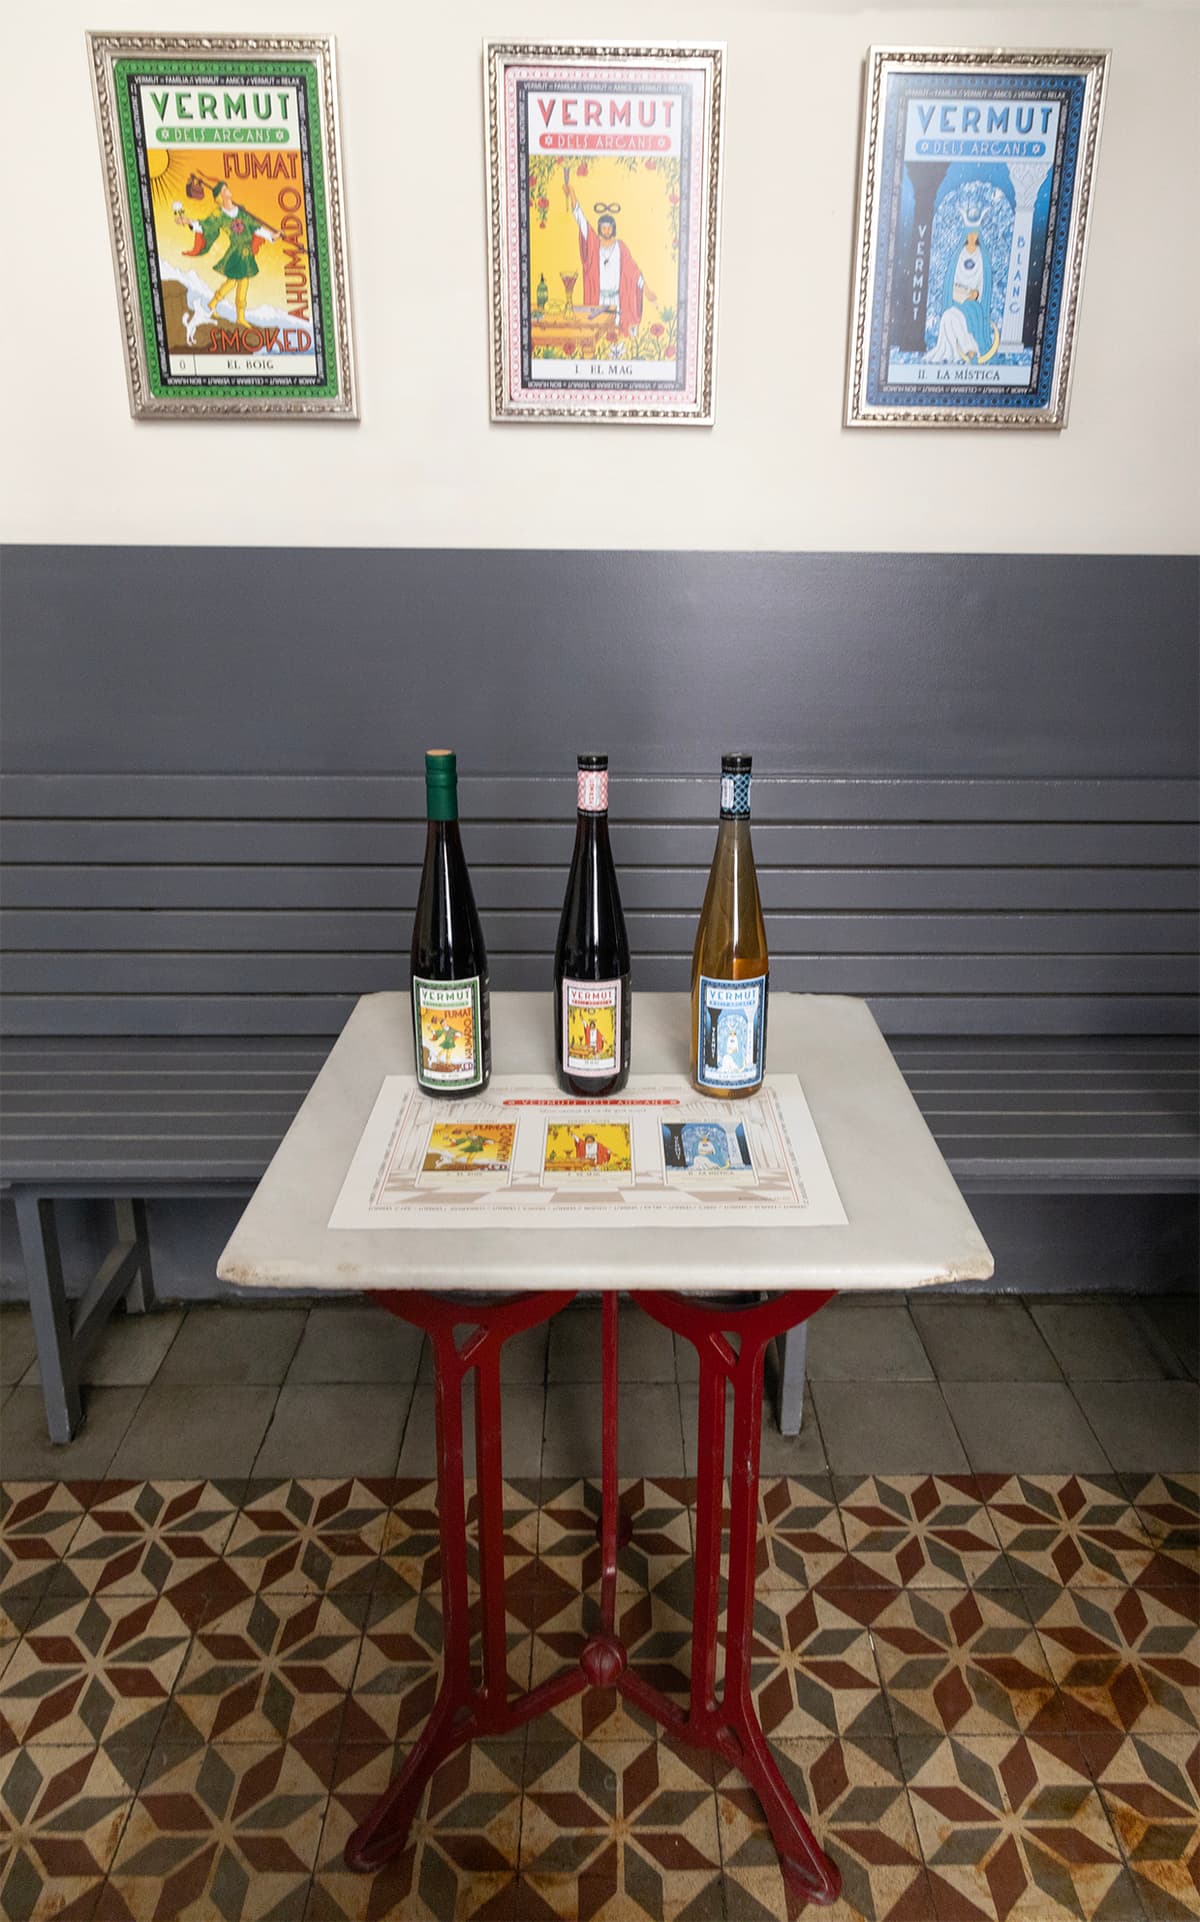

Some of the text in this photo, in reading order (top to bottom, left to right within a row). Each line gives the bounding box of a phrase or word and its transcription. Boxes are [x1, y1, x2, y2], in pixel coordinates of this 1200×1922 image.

[150, 92, 290, 121] VERMUT
[537, 98, 674, 128] VERMUT
[916, 104, 1053, 134] VERMUT
[174, 127, 271, 143] DELS ARCANS
[558, 135, 652, 150] DELS ARCANS
[934, 142, 1027, 156] DELS ARCANS
[223, 152, 298, 180] FUMAT
[278, 187, 310, 321] AHUMADO
[912, 224, 927, 321] VERMUT
[1008, 235, 1026, 314] BLANC
[209, 327, 312, 352] SMOKED
[226, 360, 241, 370] EL
[246, 360, 274, 370] BOIG
[590, 366, 604, 375] EL
[608, 366, 633, 375] MAG
[936, 370, 951, 380] LA
[954, 367, 1000, 381] MÍSTICA
[422, 990, 470, 1002] VERMUT
[571, 990, 612, 1000] VERMUT
[709, 989, 756, 1000] VERMUT
